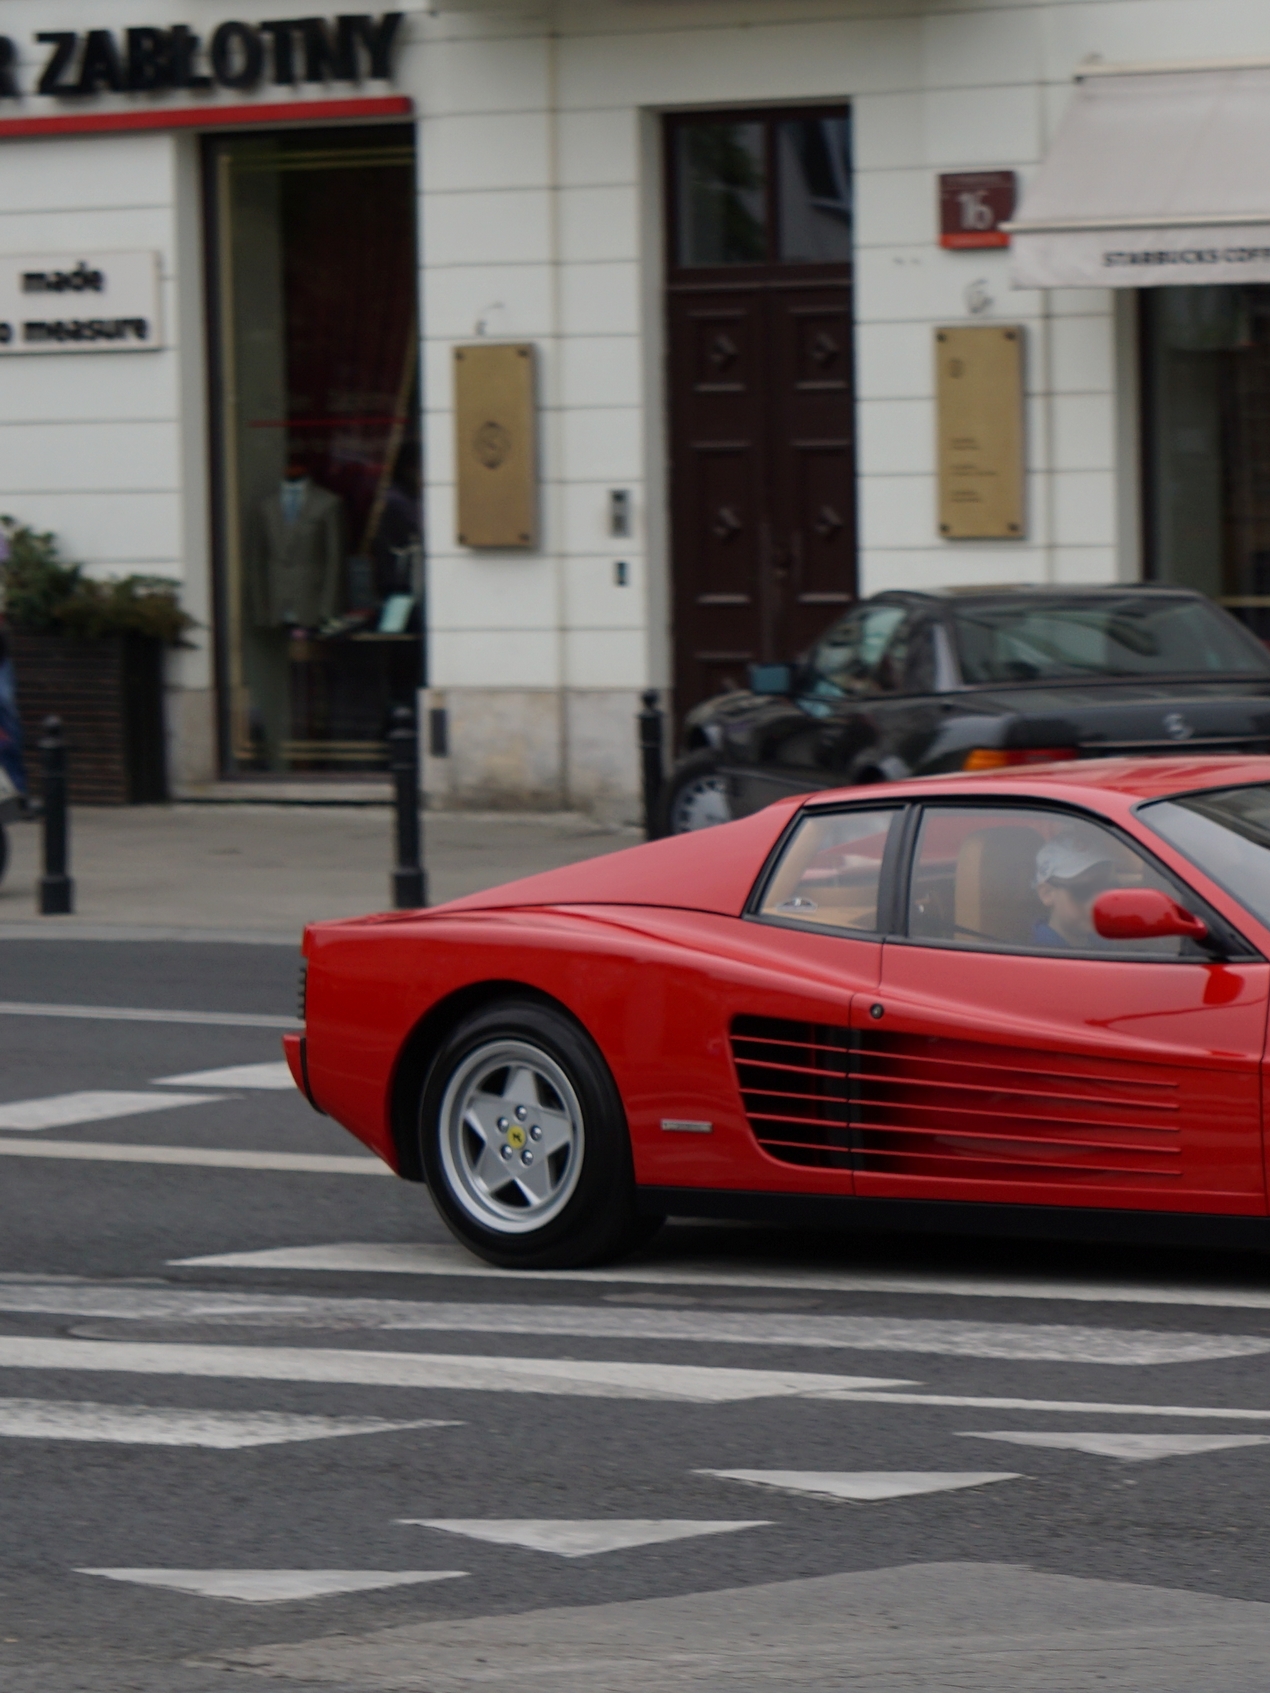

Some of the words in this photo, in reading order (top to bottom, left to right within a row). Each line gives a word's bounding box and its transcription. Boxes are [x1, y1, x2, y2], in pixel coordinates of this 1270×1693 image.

[36, 13, 403, 96] ZABŁOTNY
[1103, 249, 1218, 268] STARBUCKS
[22, 260, 104, 293] made
[23, 317, 148, 343] measure
